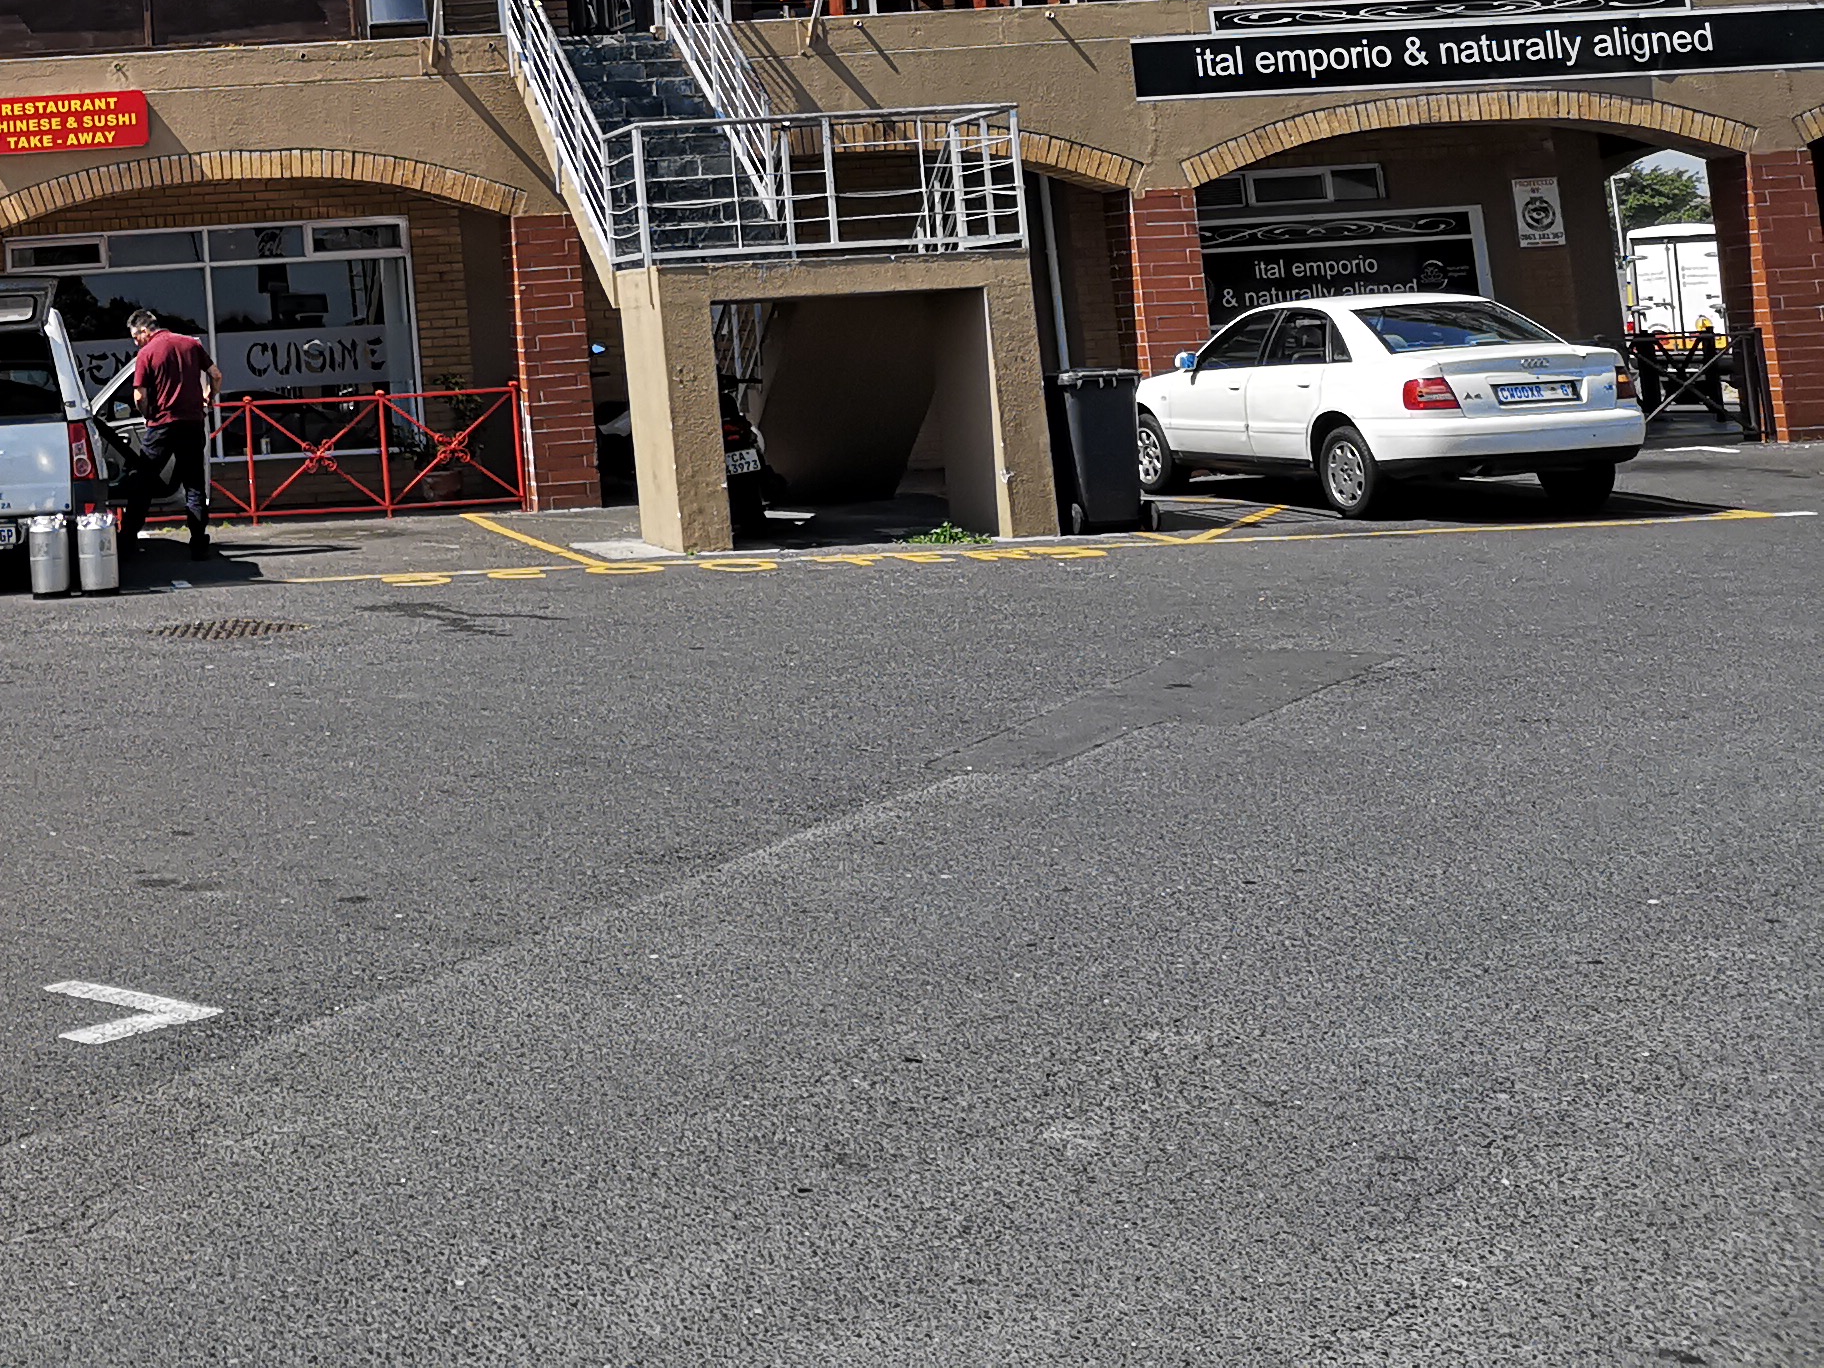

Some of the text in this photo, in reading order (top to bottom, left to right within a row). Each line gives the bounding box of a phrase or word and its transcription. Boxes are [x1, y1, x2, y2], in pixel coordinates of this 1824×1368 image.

[1196, 22, 1714, 79] ital emporio & naturally aligned
[1, 97, 118, 116] RESTAURANT
[66, 116, 78, 129] &
[83, 112, 137, 128] SUSHI
[1254, 255, 1378, 280] ital emporio
[1222, 288, 1238, 308] &
[731, 452, 746, 462] CA
[0, 528, 13, 543] GP
